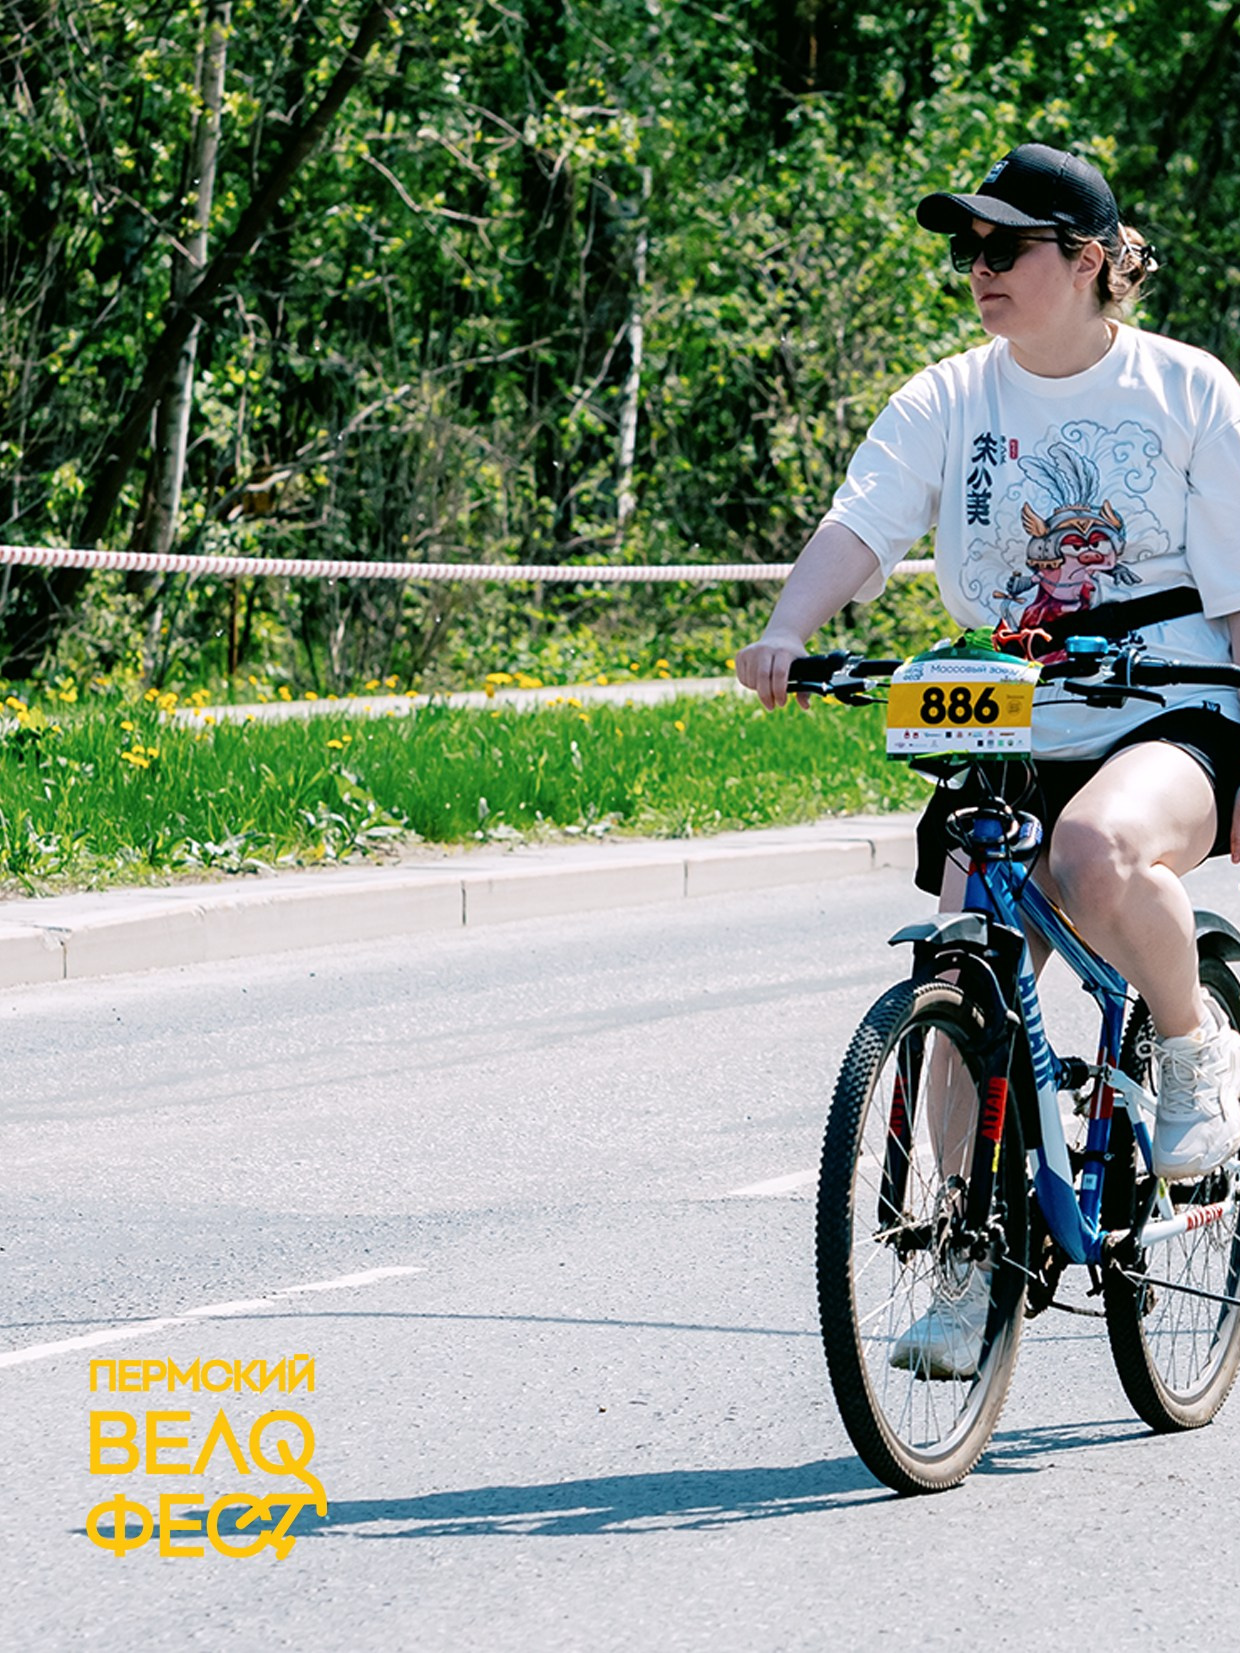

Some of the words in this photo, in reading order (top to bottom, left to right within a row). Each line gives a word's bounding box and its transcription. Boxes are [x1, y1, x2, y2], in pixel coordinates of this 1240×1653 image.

[919, 686, 999, 725] 886
[1018, 972, 1053, 1091] ALTAIR
[981, 1076, 1007, 1141] ALTAIR
